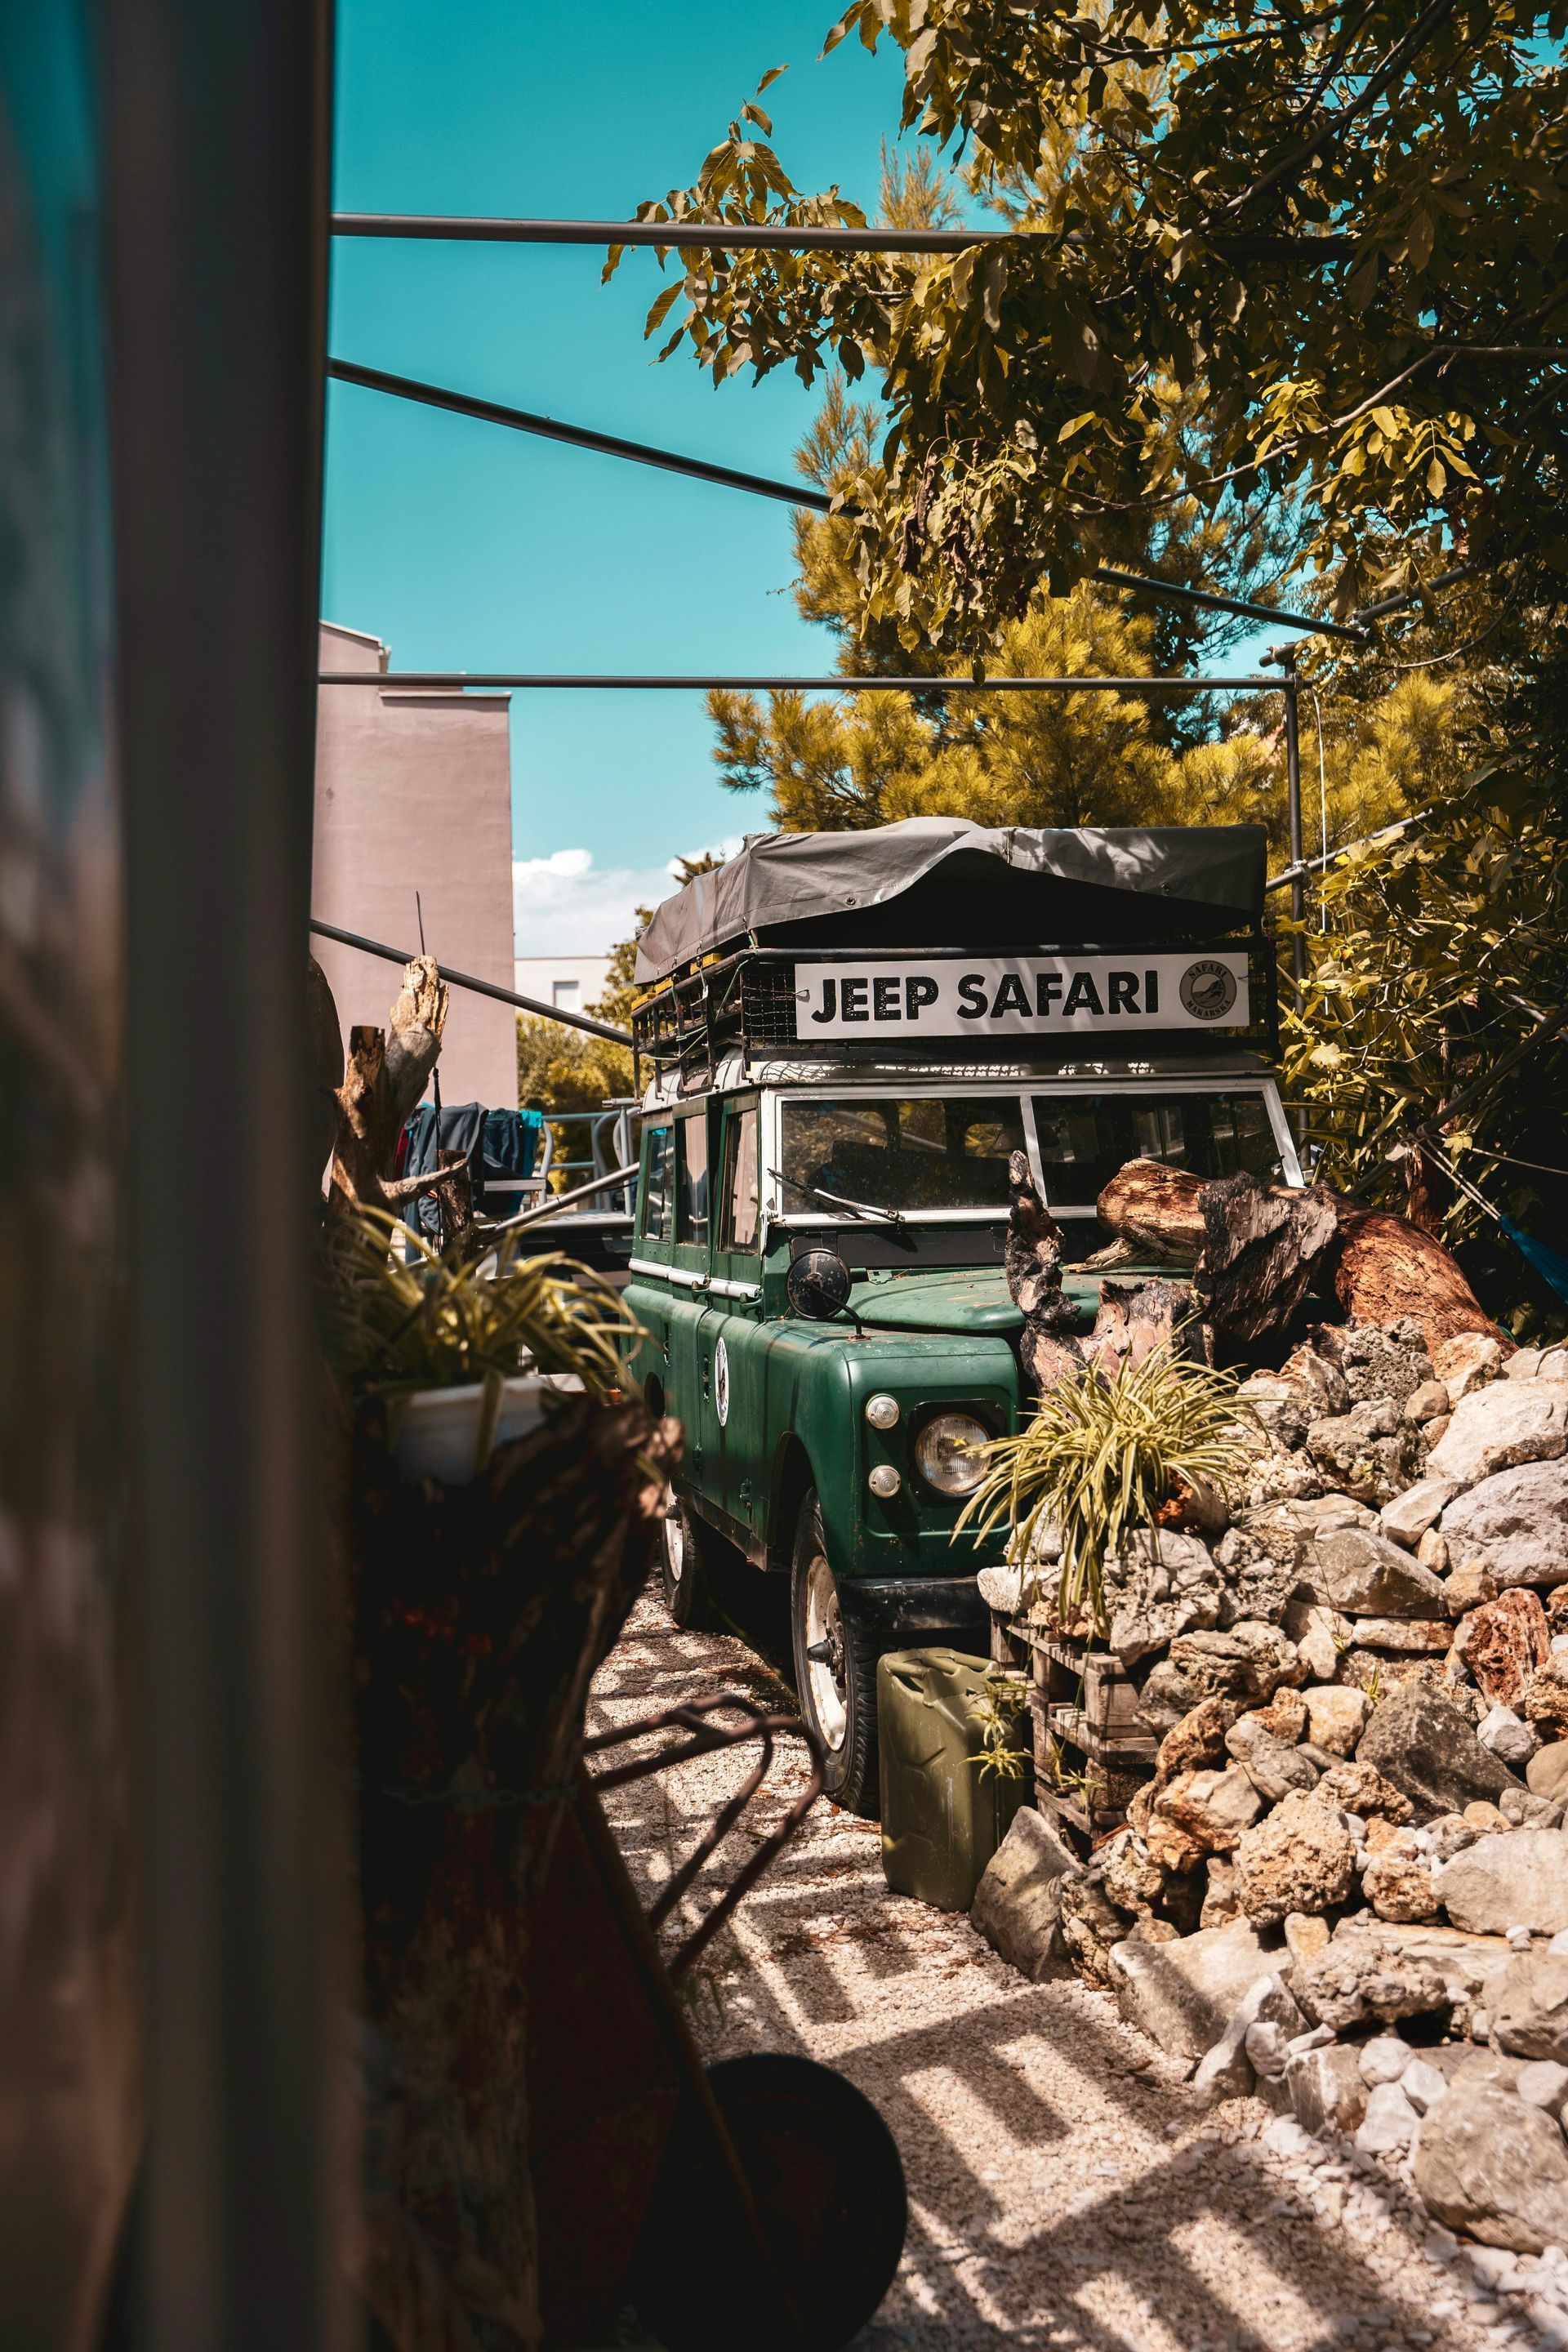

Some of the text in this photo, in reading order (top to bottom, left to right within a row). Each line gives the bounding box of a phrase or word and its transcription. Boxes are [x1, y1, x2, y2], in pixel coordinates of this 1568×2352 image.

[1188, 964, 1227, 979] SAFARI
[812, 970, 1159, 1022] JEEP SAFARI
[1187, 1000, 1231, 1017] MAKARSKA
